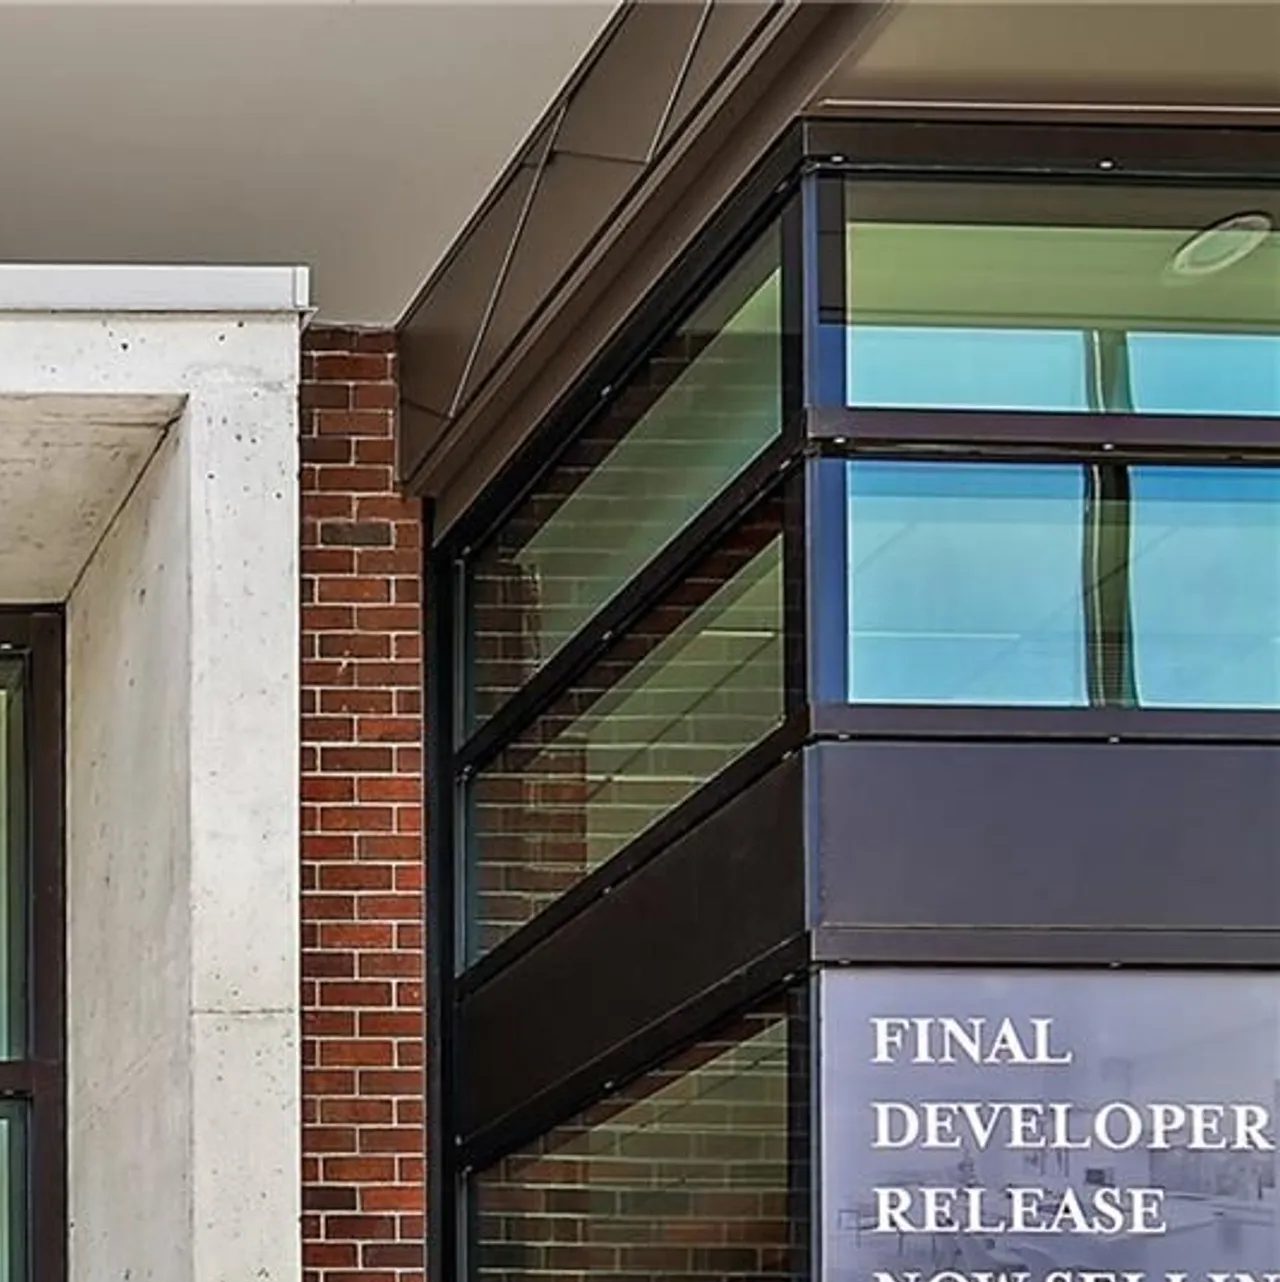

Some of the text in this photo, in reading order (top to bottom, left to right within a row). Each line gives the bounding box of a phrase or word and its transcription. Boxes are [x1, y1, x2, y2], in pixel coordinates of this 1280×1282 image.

[870, 1017, 1073, 1065] FINAL
[871, 1102, 1277, 1151] DEVELOPER
[873, 1187, 1167, 1236] RELEASE
